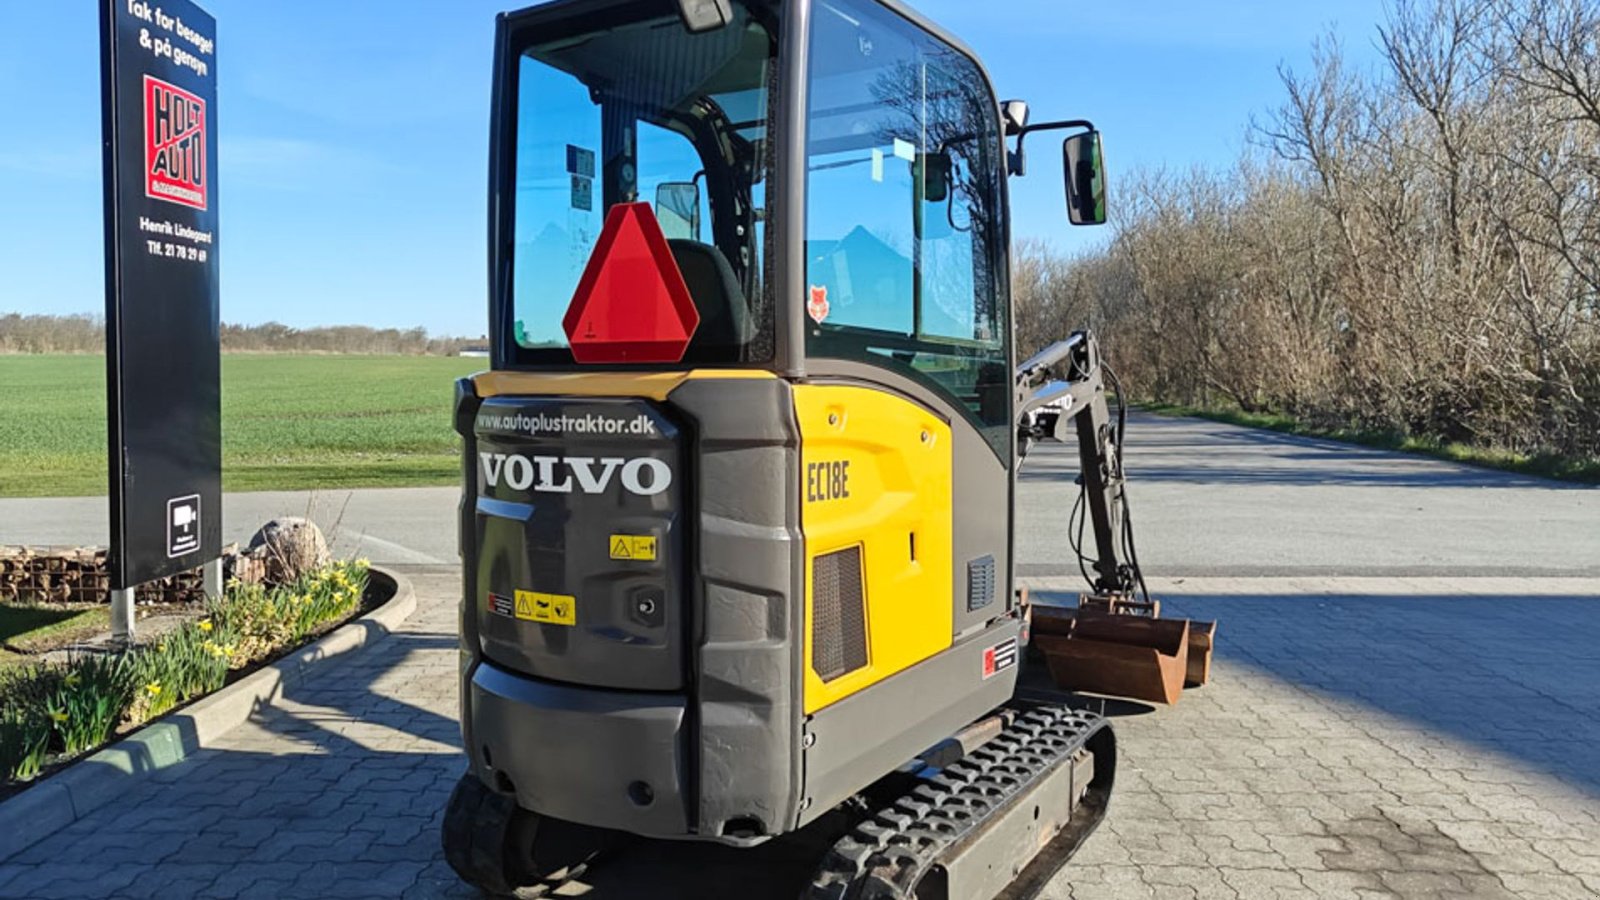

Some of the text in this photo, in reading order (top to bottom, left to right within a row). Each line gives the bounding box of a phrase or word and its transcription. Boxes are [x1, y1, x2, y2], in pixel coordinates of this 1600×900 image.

[139, 28, 208, 76] & på gensyn
[155, 7, 175, 31] for
[176, 17, 214, 55] besøget
[153, 86, 201, 145] HOLT
[152, 131, 203, 187] AUTO
[139, 216, 173, 235] Henrik
[477, 413, 656, 435] www.autoplustraktor.dk
[479, 452, 672, 495] VOLVO
[807, 460, 850, 503] EC18E
